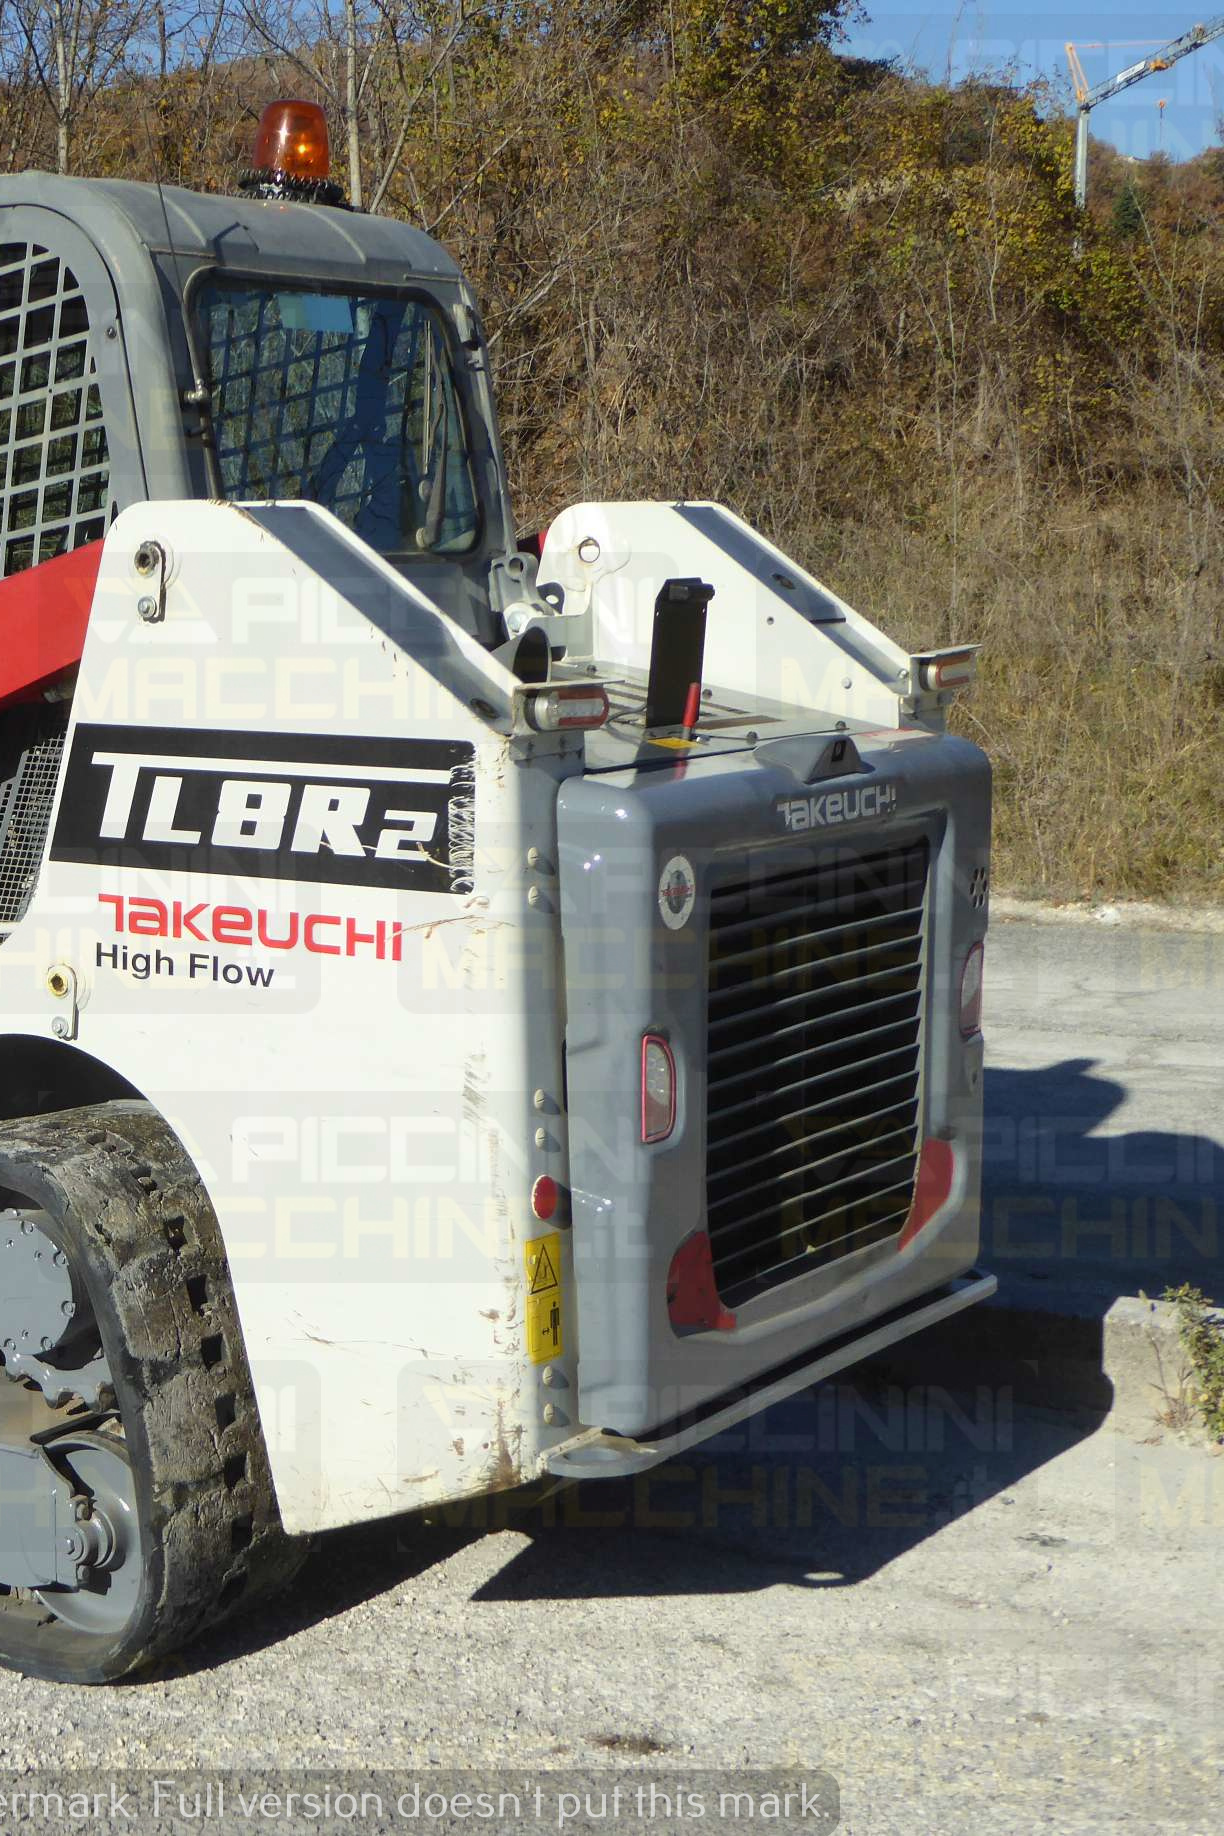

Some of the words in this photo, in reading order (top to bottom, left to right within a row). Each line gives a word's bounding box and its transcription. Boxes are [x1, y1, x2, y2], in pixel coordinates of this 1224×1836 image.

[91, 751, 446, 862] TL8R2
[96, 942, 174, 980] High
[189, 953, 275, 988] Flow
